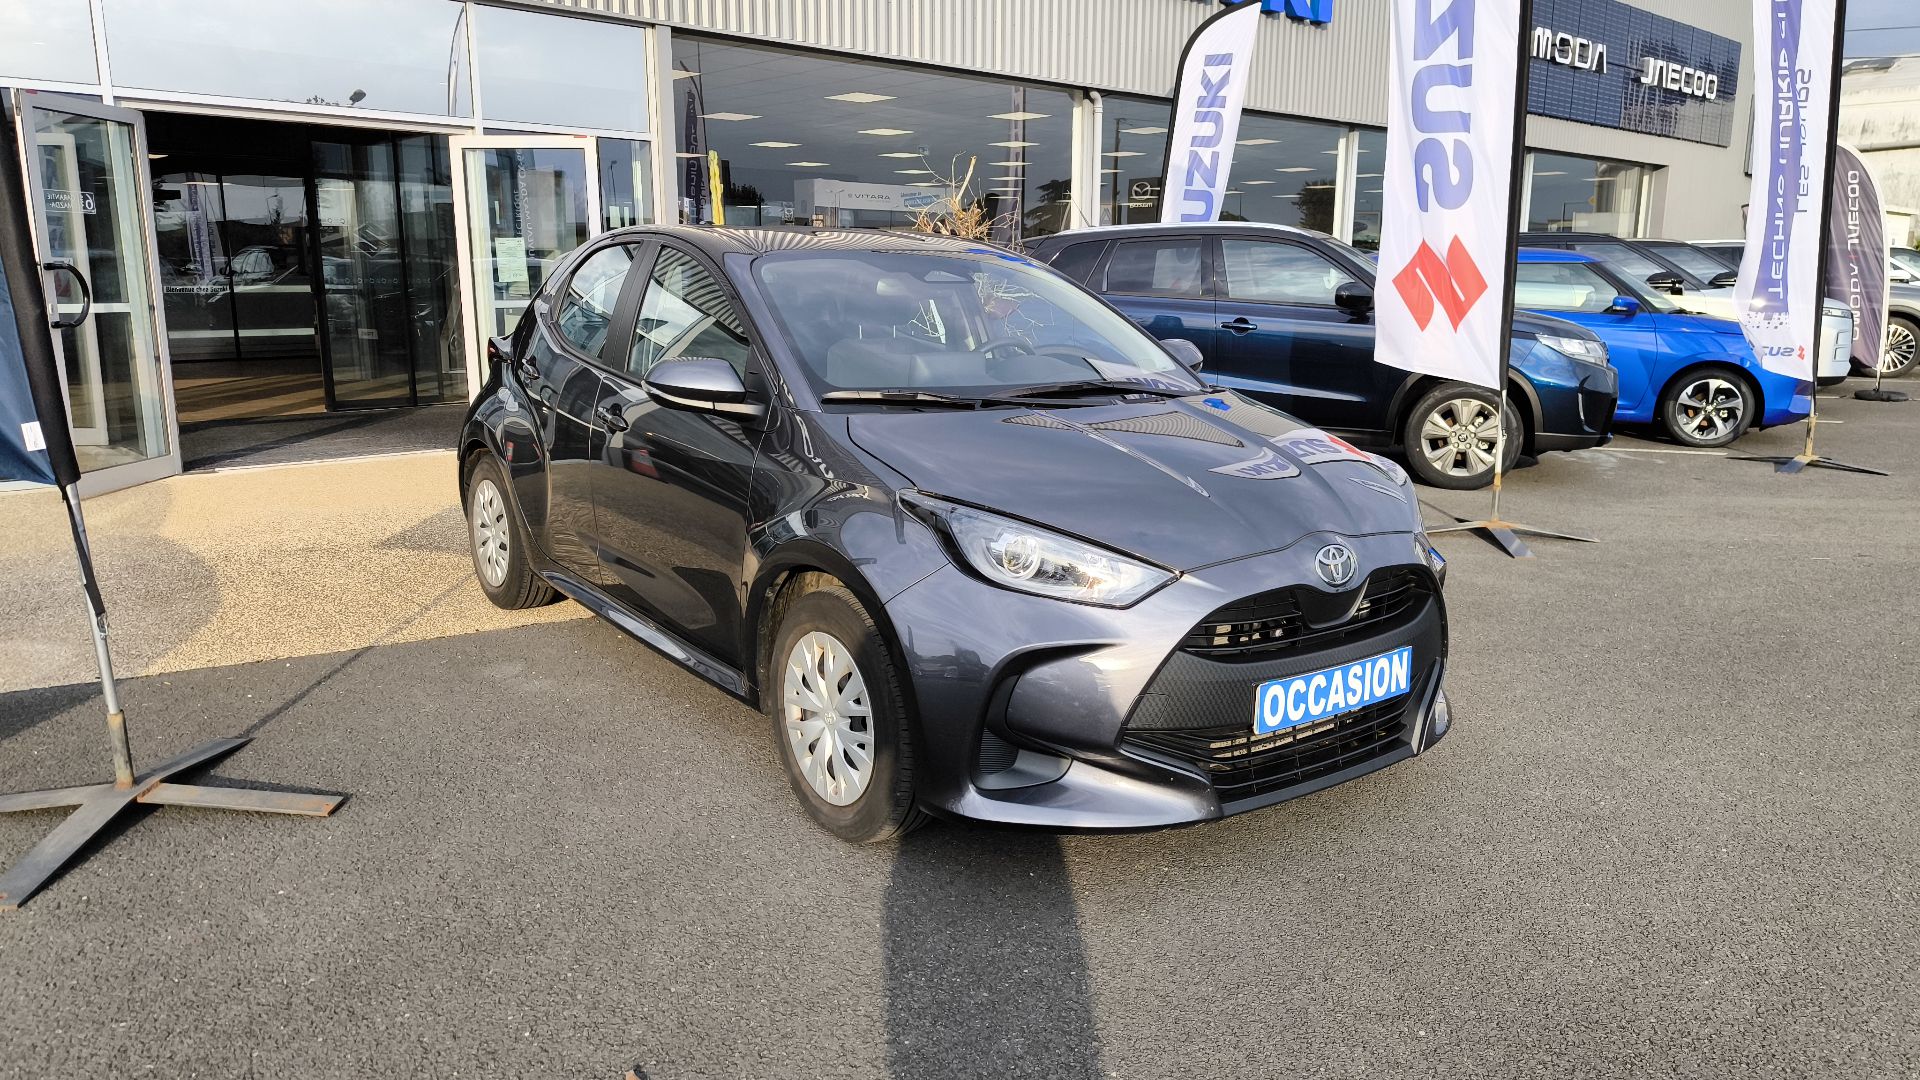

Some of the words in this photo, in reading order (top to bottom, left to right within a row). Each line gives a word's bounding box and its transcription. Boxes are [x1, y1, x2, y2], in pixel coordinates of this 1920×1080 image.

[1640, 56, 1719, 100] JAECOO
[1180, 53, 1234, 222] UZUKI
[1262, 651, 1409, 728] OCCASION
